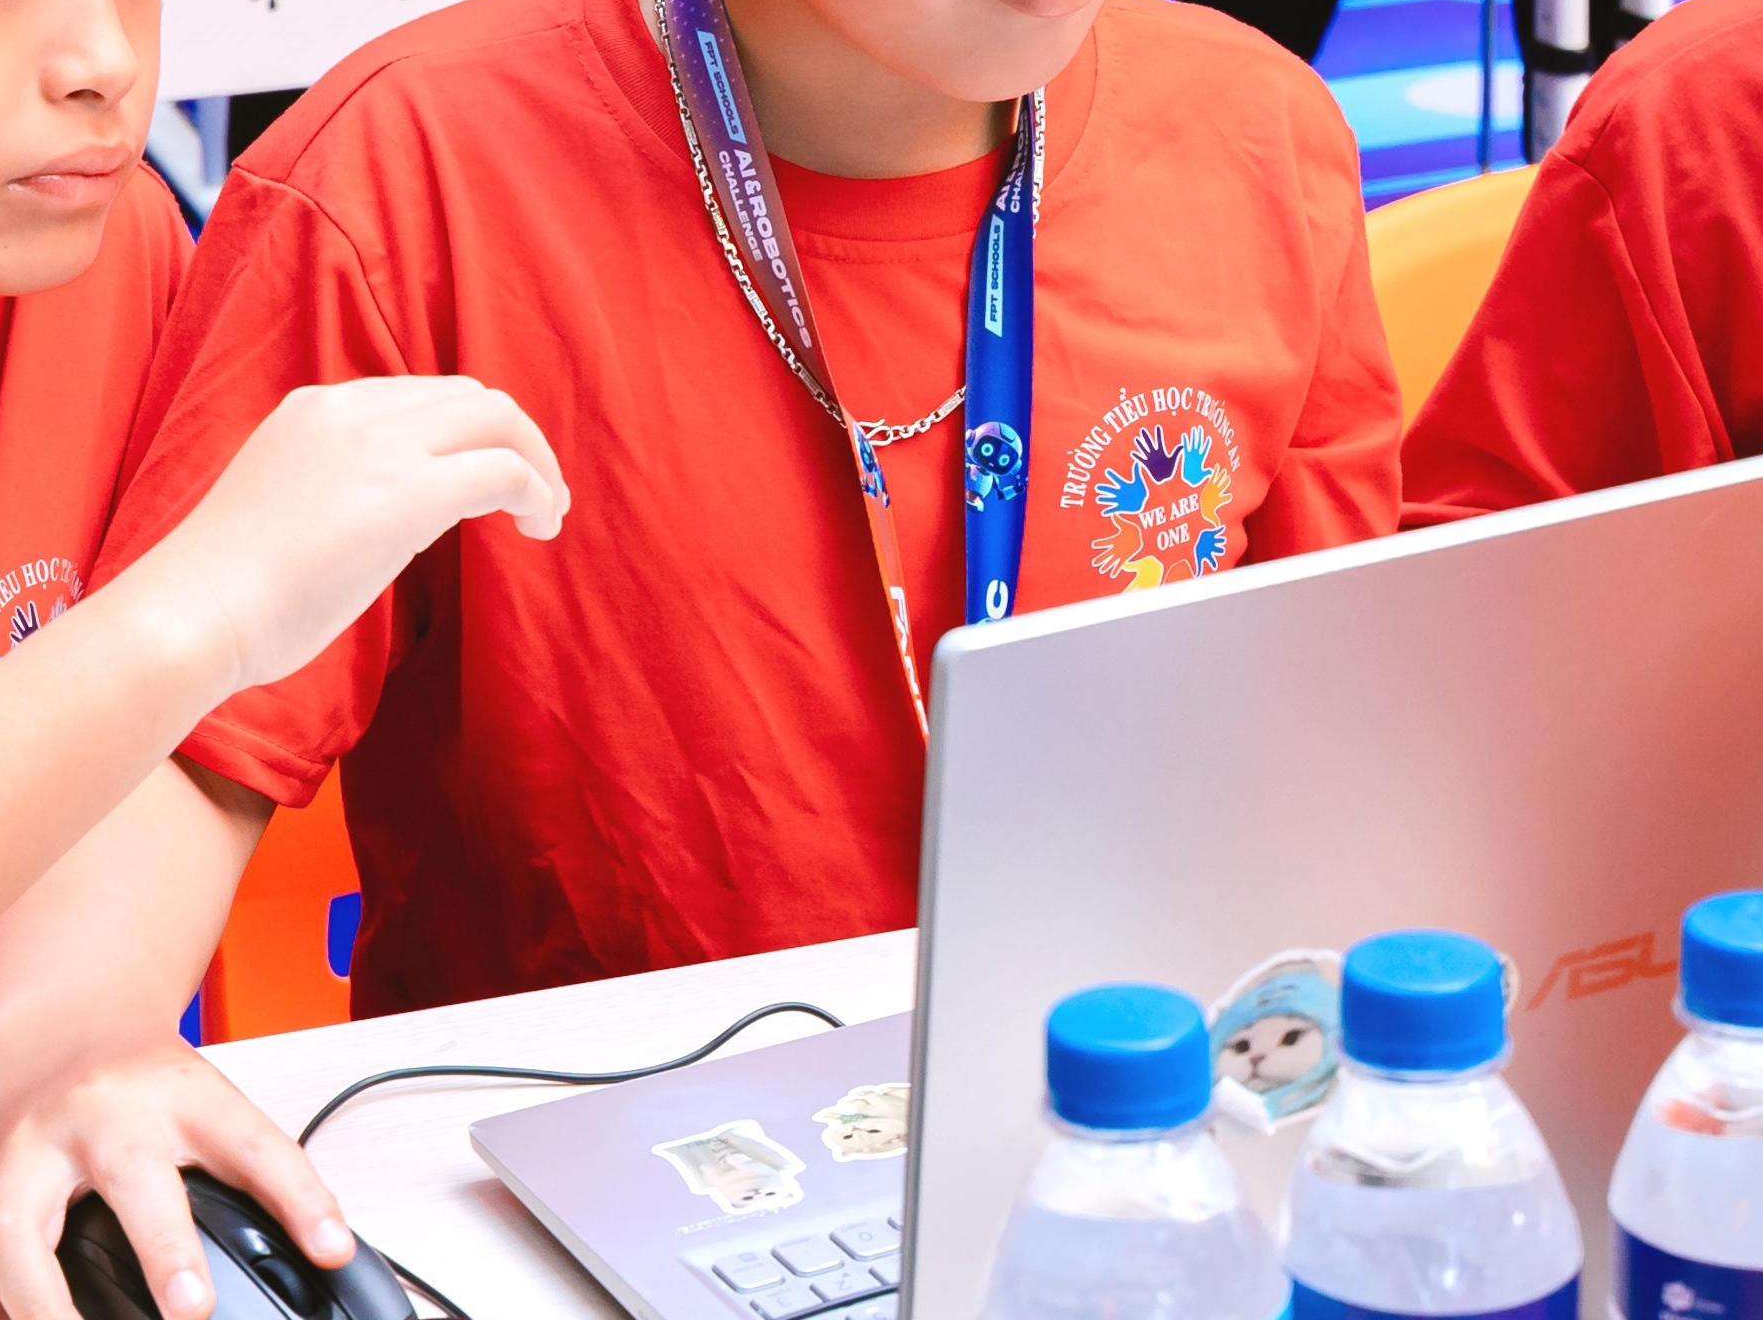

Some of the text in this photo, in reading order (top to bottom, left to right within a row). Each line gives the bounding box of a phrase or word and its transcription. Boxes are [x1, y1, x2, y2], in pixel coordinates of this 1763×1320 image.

[704, 40, 740, 135] FPT SCHOOLS
[719, 150, 764, 261] CHALLENGE
[990, 225, 1000, 322] FPT SCHOOLS
[1060, 426, 1112, 508] TRƯỜNG
[1103, 387, 1149, 434] TIỂU
[1152, 386, 1193, 416] HỌC
[1227, 446, 1241, 472] AN
[1138, 493, 1200, 530] WE ARE
[1157, 523, 1190, 551] ONE
[21, 557, 60, 589] HỌC
